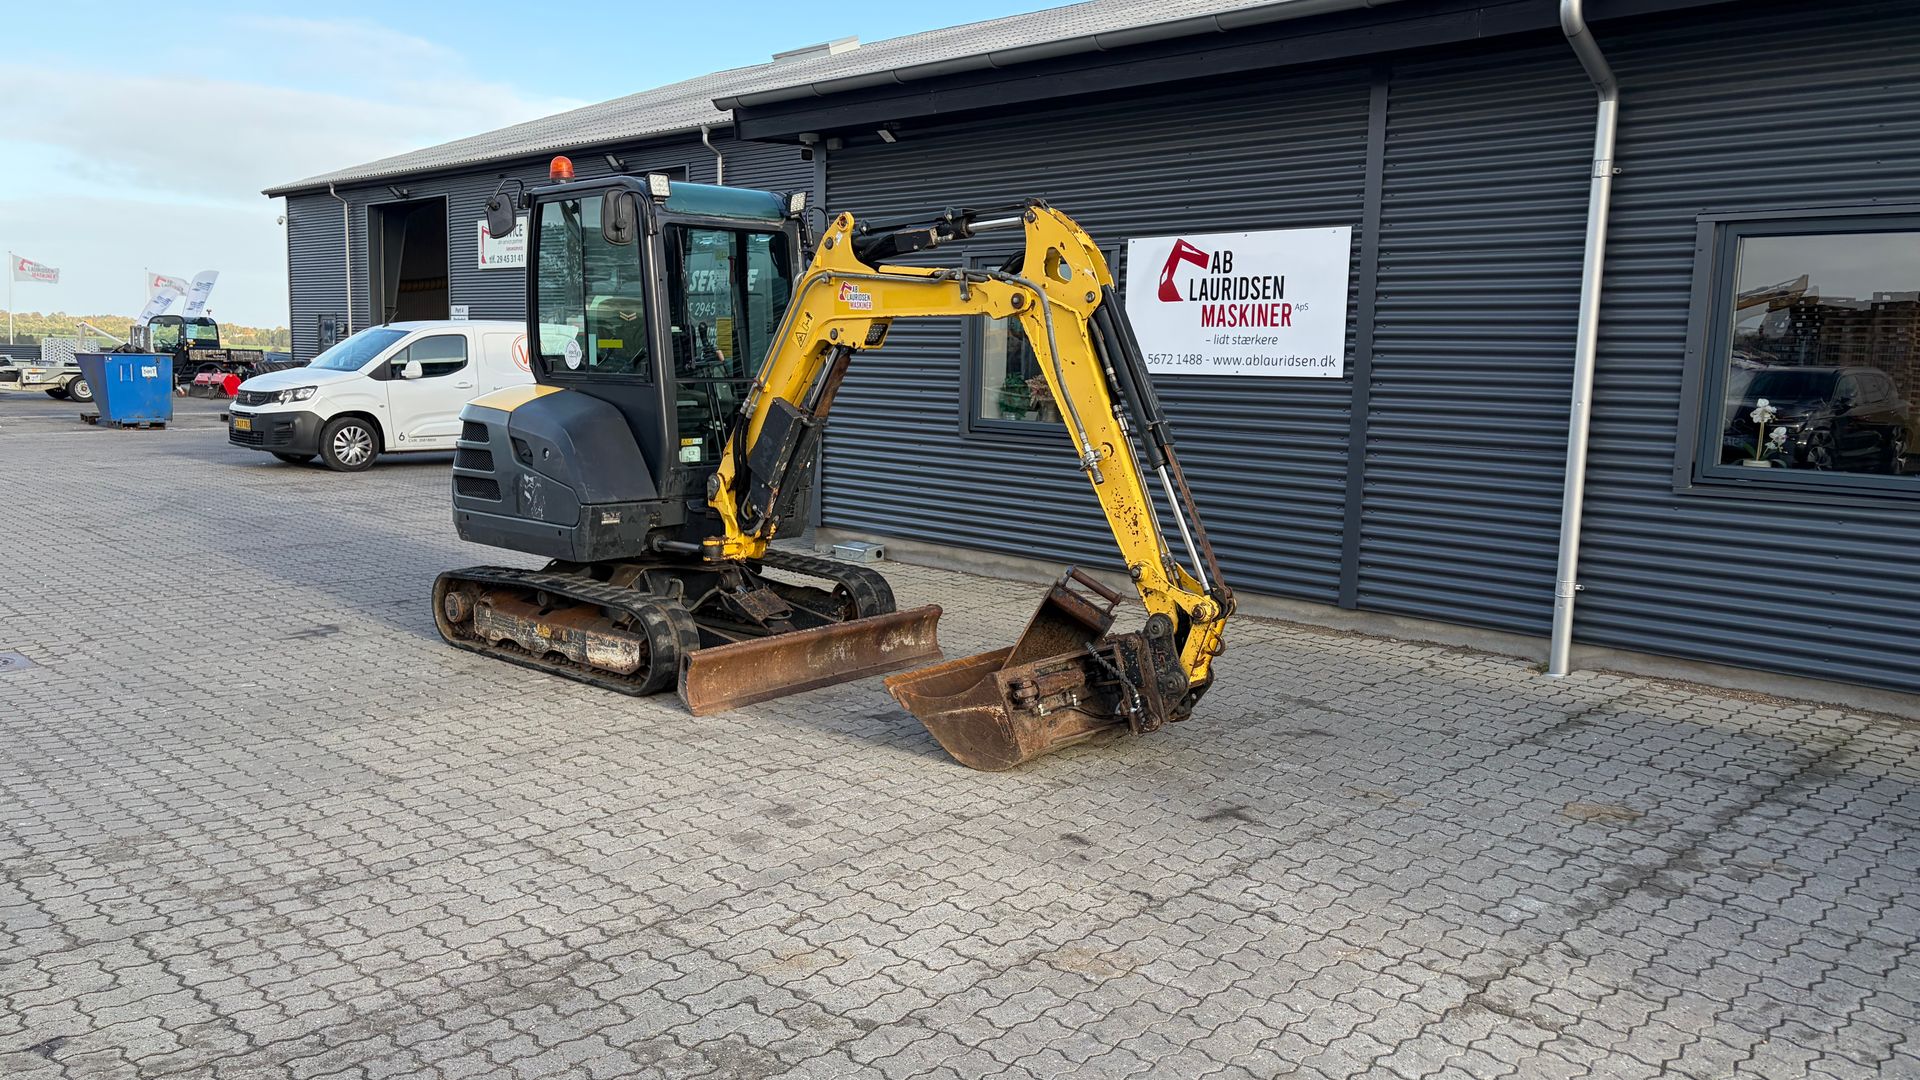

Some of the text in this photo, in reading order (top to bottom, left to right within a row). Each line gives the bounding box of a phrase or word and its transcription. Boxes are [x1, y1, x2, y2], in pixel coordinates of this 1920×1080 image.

[496, 255, 503, 264] 29
[503, 254, 510, 263] 45
[517, 254, 524, 263] 41
[1211, 250, 1233, 274] AB
[1189, 275, 1285, 302] LAURIDSEN
[1201, 302, 1309, 328] MASKINER ApS
[1213, 333, 1230, 345] lidt
[1231, 334, 1278, 345] stærkere
[1147, 352, 1174, 365] 5672
[1175, 353, 1203, 365] 1488
[1212, 353, 1337, 368] www.ablauridsen.dk
[398, 431, 405, 442] 6
